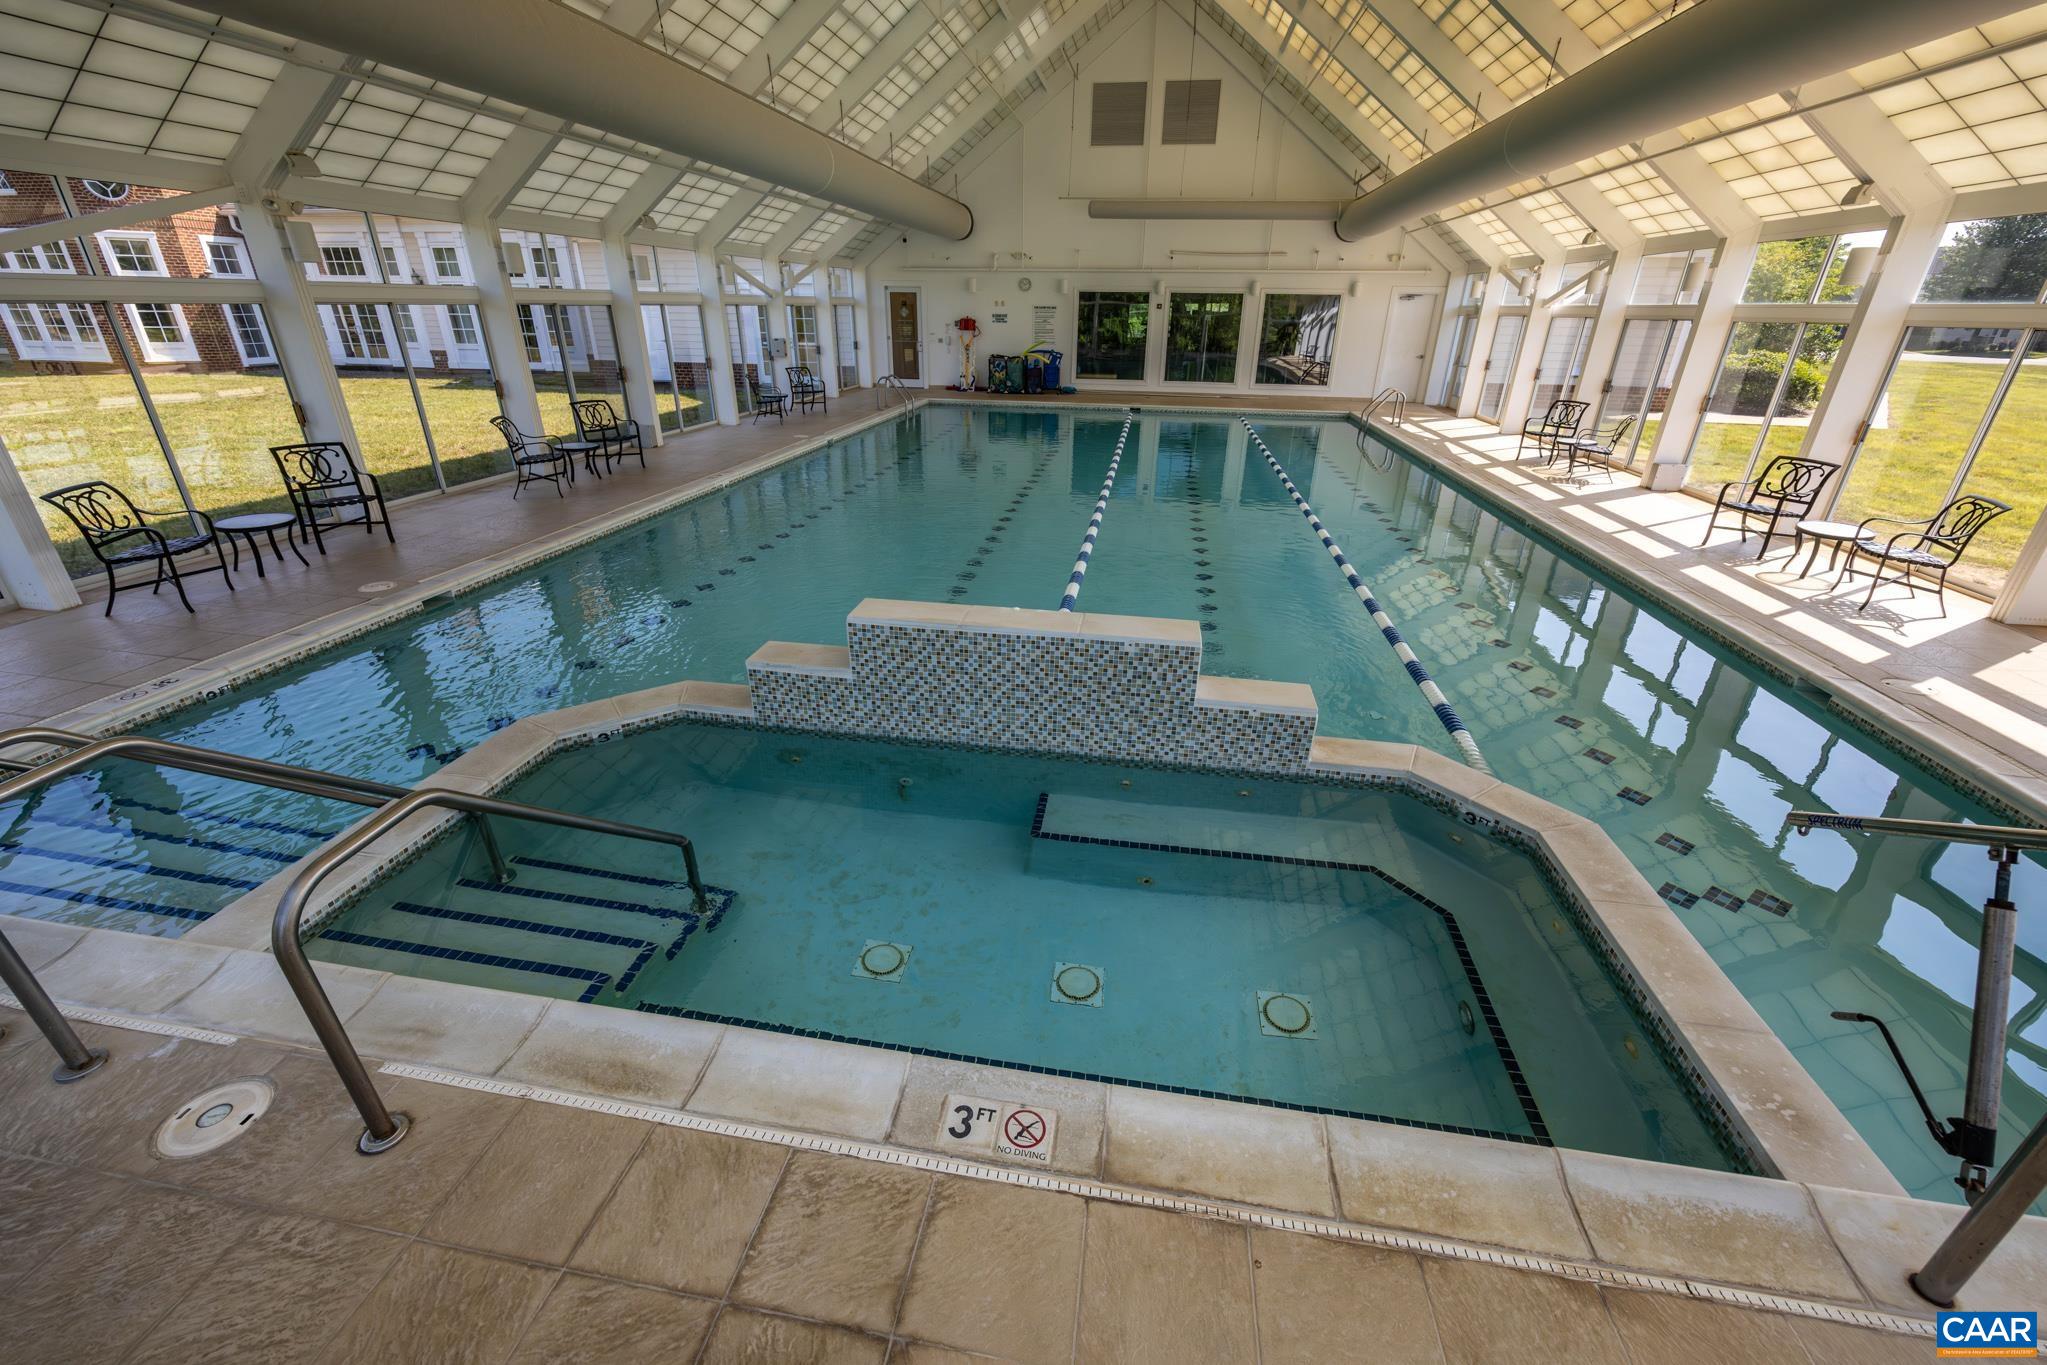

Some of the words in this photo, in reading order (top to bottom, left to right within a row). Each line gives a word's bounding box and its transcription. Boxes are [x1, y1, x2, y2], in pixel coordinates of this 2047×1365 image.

[598, 733, 610, 743] 3
[1463, 811, 1477, 826] 3
[1478, 816, 1491, 827] FT
[1807, 814, 1863, 831] SPECTRUM
[948, 1104, 974, 1139] 3
[976, 1107, 997, 1122] FT
[996, 1145, 1012, 1156] NO
[1014, 1147, 1047, 1161] DIVING
